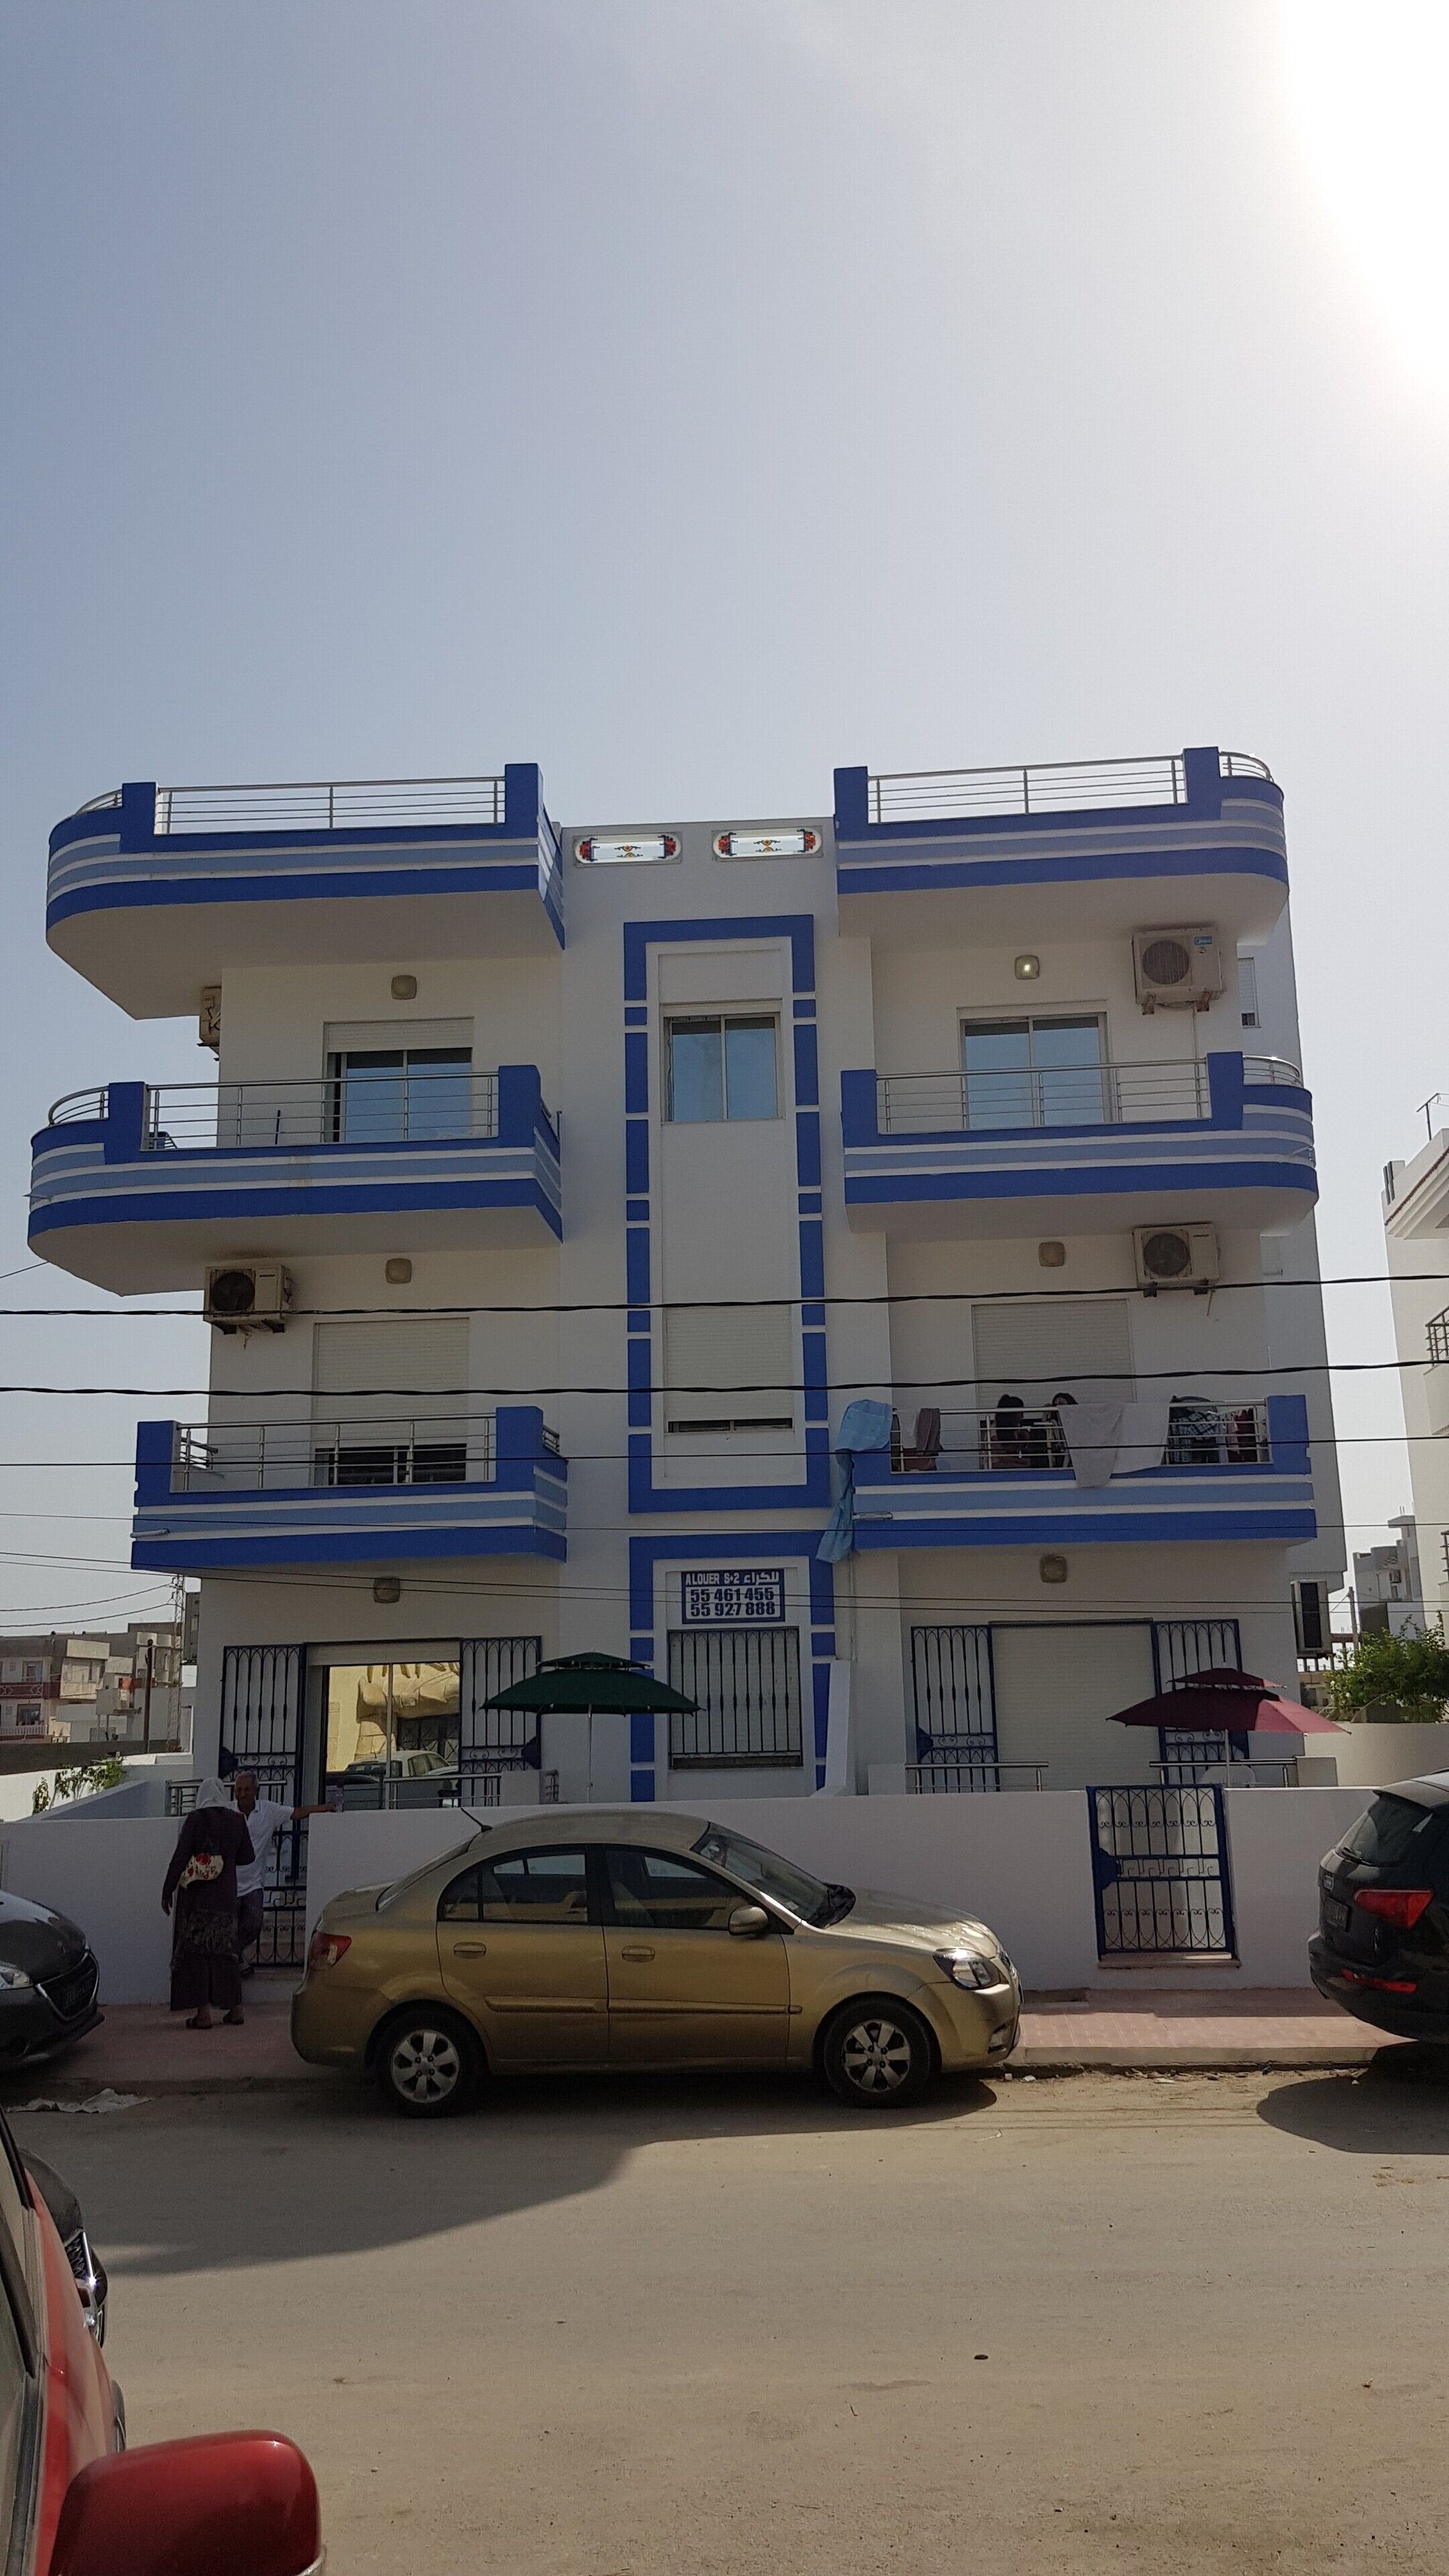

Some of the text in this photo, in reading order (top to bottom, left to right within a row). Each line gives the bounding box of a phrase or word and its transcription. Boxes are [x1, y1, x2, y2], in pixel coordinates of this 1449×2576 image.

[690, 1587, 774, 1603] 55 461 455
[690, 1601, 775, 1617] 55 927 888
